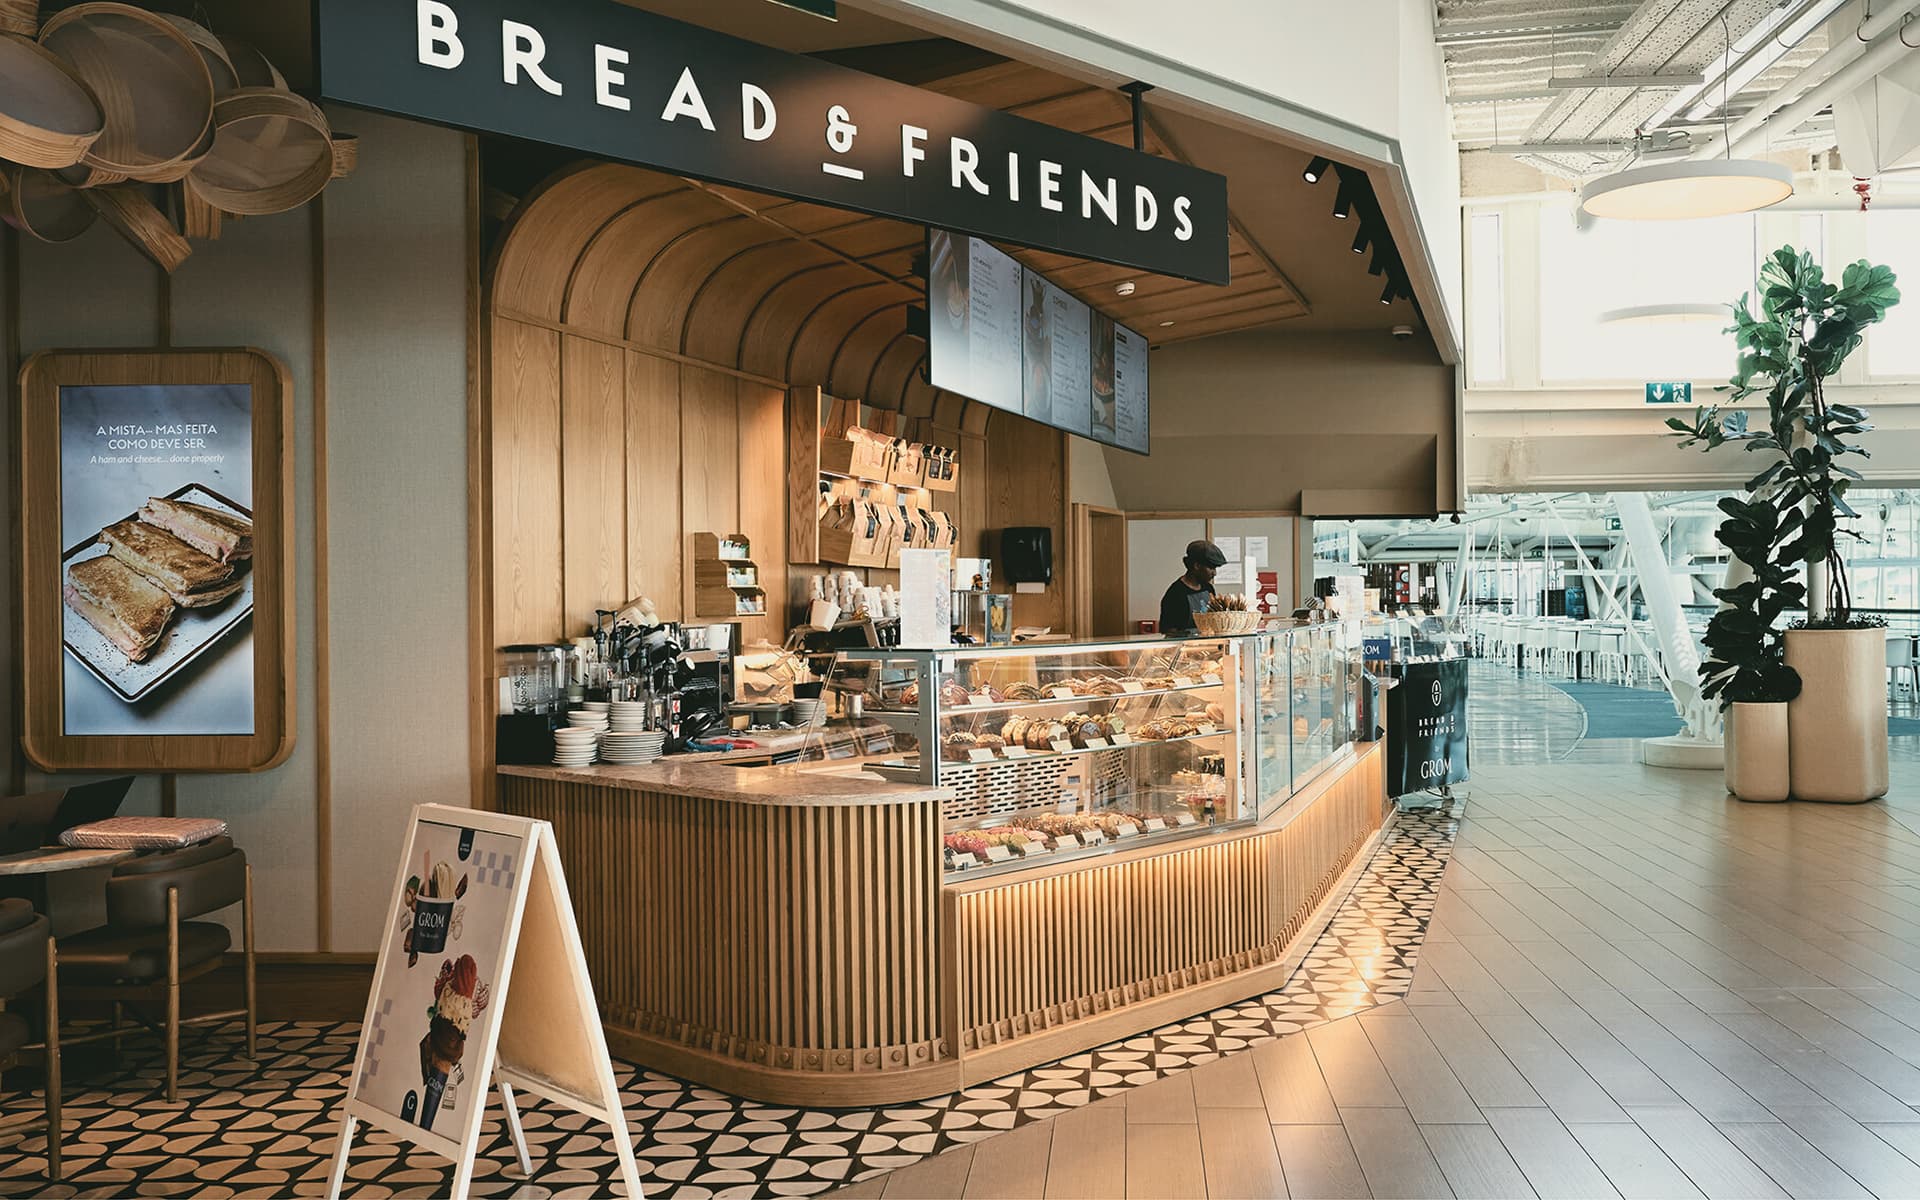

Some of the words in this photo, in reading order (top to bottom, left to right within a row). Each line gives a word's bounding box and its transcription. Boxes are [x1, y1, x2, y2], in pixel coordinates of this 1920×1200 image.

[417, 0, 777, 141] BREAD
[901, 123, 1193, 241] FRIENDS
[96, 426, 107, 435] A
[155, 424, 182, 435] MAS
[185, 424, 218, 434] FEITA
[108, 439, 148, 450] COMO
[151, 439, 181, 449] DEVE
[183, 438, 206, 449] SER
[89, 455, 98, 464] A
[98, 455, 116, 464] ham
[117, 454, 133, 464] and
[169, 454, 190, 463] done
[191, 453, 225, 464] properly
[1419, 716, 1445, 727] BREAD
[1419, 726, 1455, 737] FRIENDS
[1421, 758, 1452, 779] GROM
[418, 912, 445, 928] GROM
